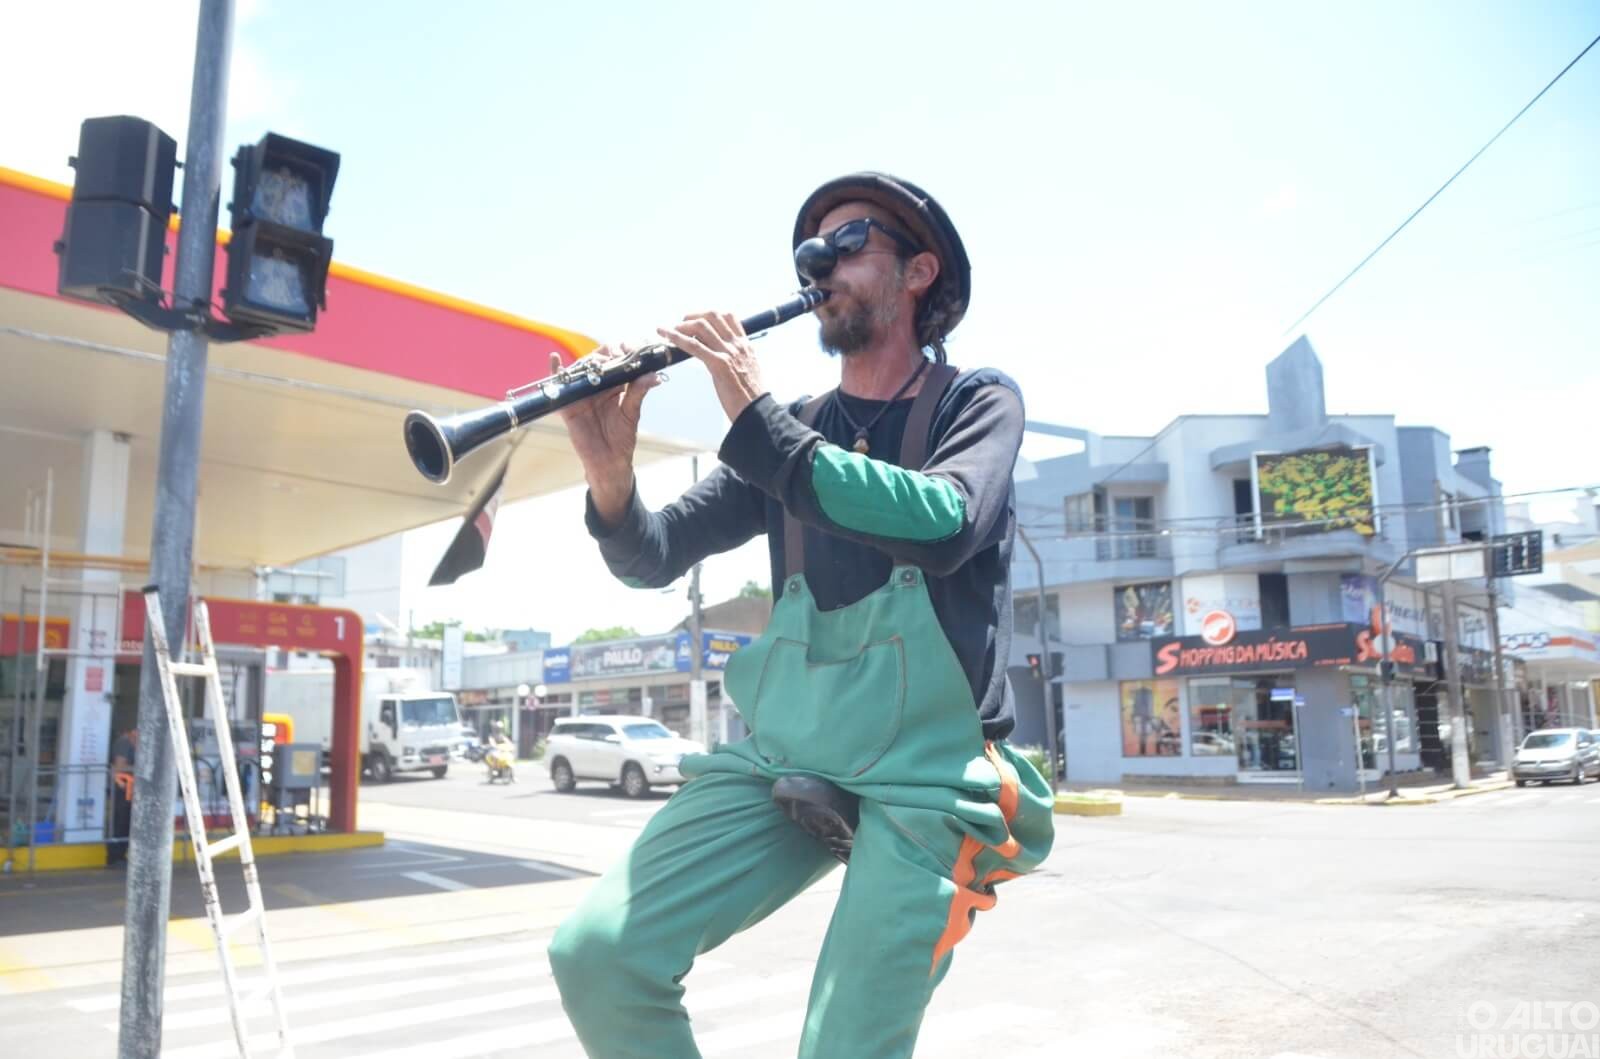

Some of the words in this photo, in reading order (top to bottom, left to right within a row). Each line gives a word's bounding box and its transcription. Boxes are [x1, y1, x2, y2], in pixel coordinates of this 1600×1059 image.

[334, 616, 345, 640] 1
[603, 648, 642, 666] PAULO
[1156, 641, 1234, 674] SHOPPING
[1235, 645, 1256, 663] DA
[1255, 636, 1307, 662] MÚSICA
